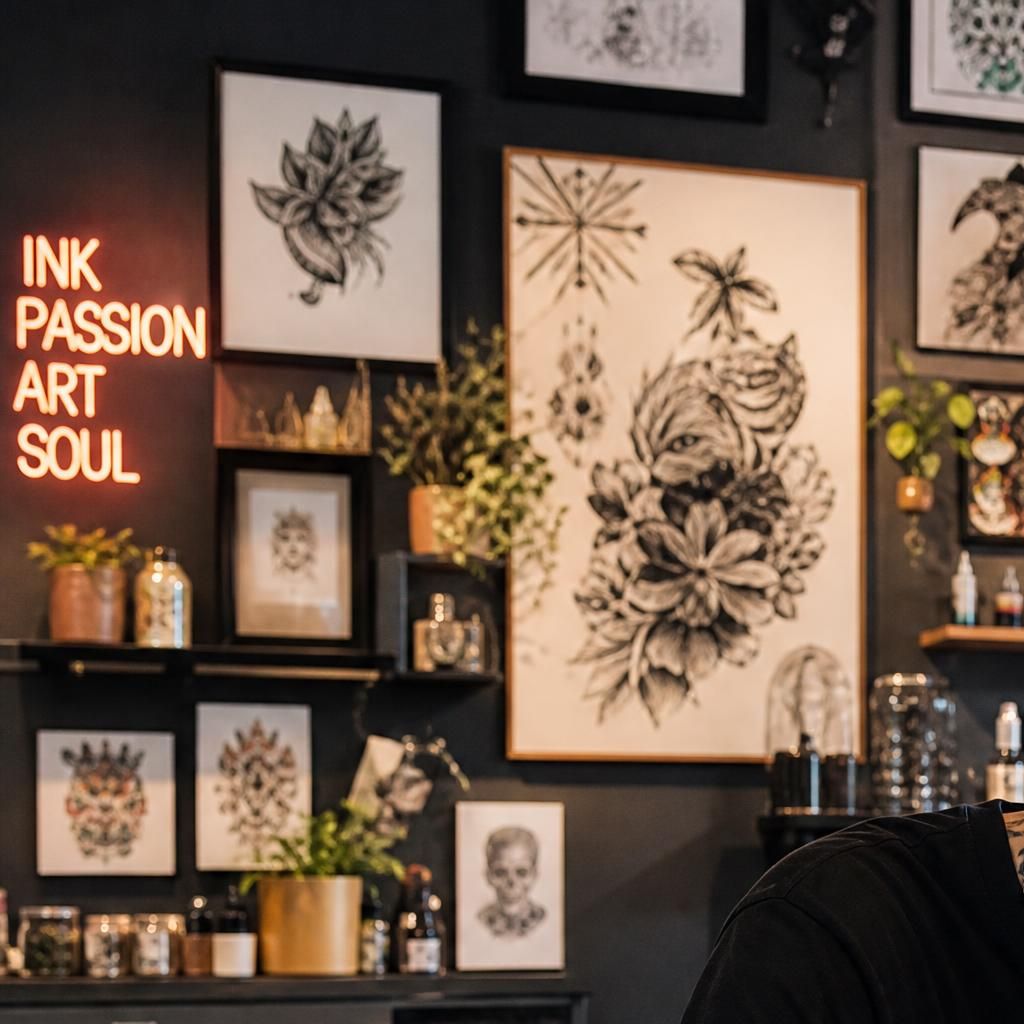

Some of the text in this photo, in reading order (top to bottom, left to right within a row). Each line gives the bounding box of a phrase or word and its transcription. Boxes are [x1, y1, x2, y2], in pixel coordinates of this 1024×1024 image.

[23, 235, 102, 292] INK
[16, 296, 206, 359] PASSION
[12, 360, 107, 418] ART
[17, 423, 141, 484] SOUL
